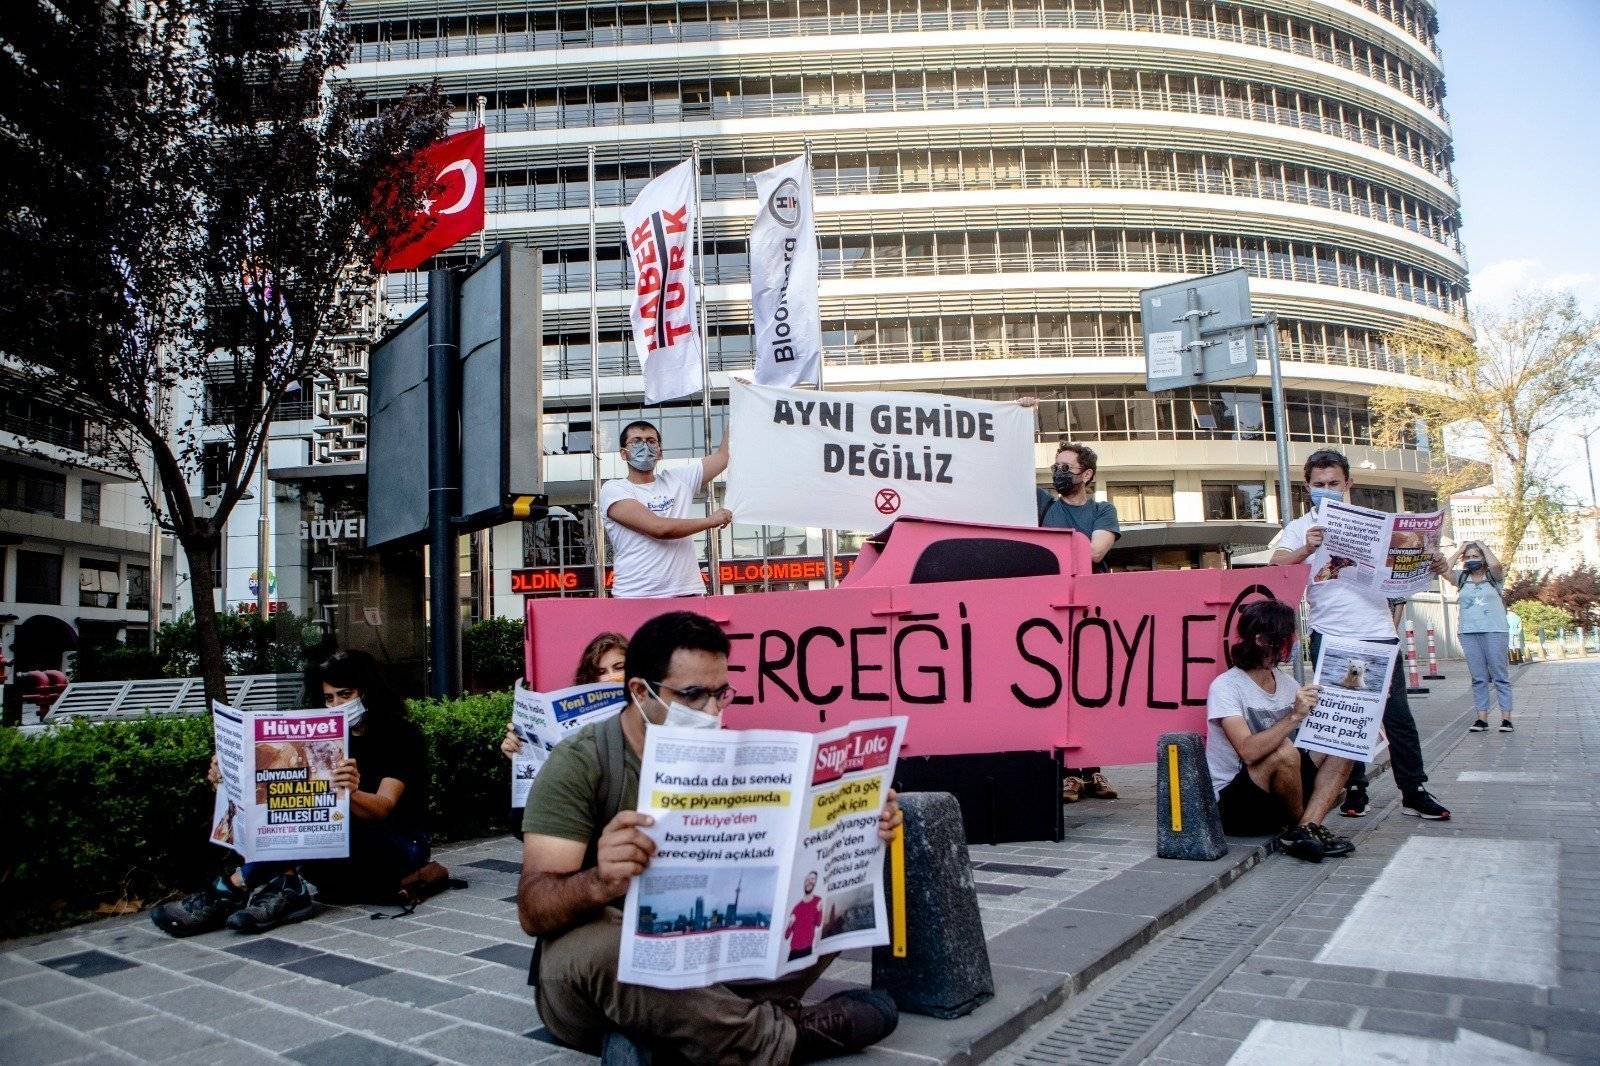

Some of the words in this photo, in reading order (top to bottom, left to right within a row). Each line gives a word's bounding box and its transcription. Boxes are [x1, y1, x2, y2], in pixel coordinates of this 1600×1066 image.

[773, 399, 854, 432] AYNI
[870, 402, 995, 442] GEMİDE
[823, 441, 954, 484] DEĞİLİZ
[727, 601, 971, 723] ERÇEĞİ
[1010, 606, 1216, 709] SÖYLE
[559, 696, 585, 712] Yeni
[1309, 708, 1329, 720] son
[262, 718, 338, 738] Hüviyet
[1305, 719, 1336, 734] hayat
[1338, 727, 1368, 740] parkı
[256, 768, 308, 782] DÜNYADAKİ
[655, 772, 709, 787] Kanada
[711, 774, 729, 787] da
[731, 774, 746, 786] bu
[749, 773, 793, 785] seneki
[269, 782, 293, 795] SON
[295, 780, 328, 794] ALTIN
[269, 793, 336, 809] MADENİNİN
[661, 794, 688, 808] göç
[690, 791, 781, 809] piyangosunda
[271, 809, 312, 824] İHALESİ
[313, 809, 328, 822] DE
[682, 812, 758, 828] Türkiye'den
[665, 831, 745, 843] başvurulara
[748, 830, 768, 844] yer
[657, 848, 723, 862] ereceğini
[725, 847, 775, 861] açıkladı
